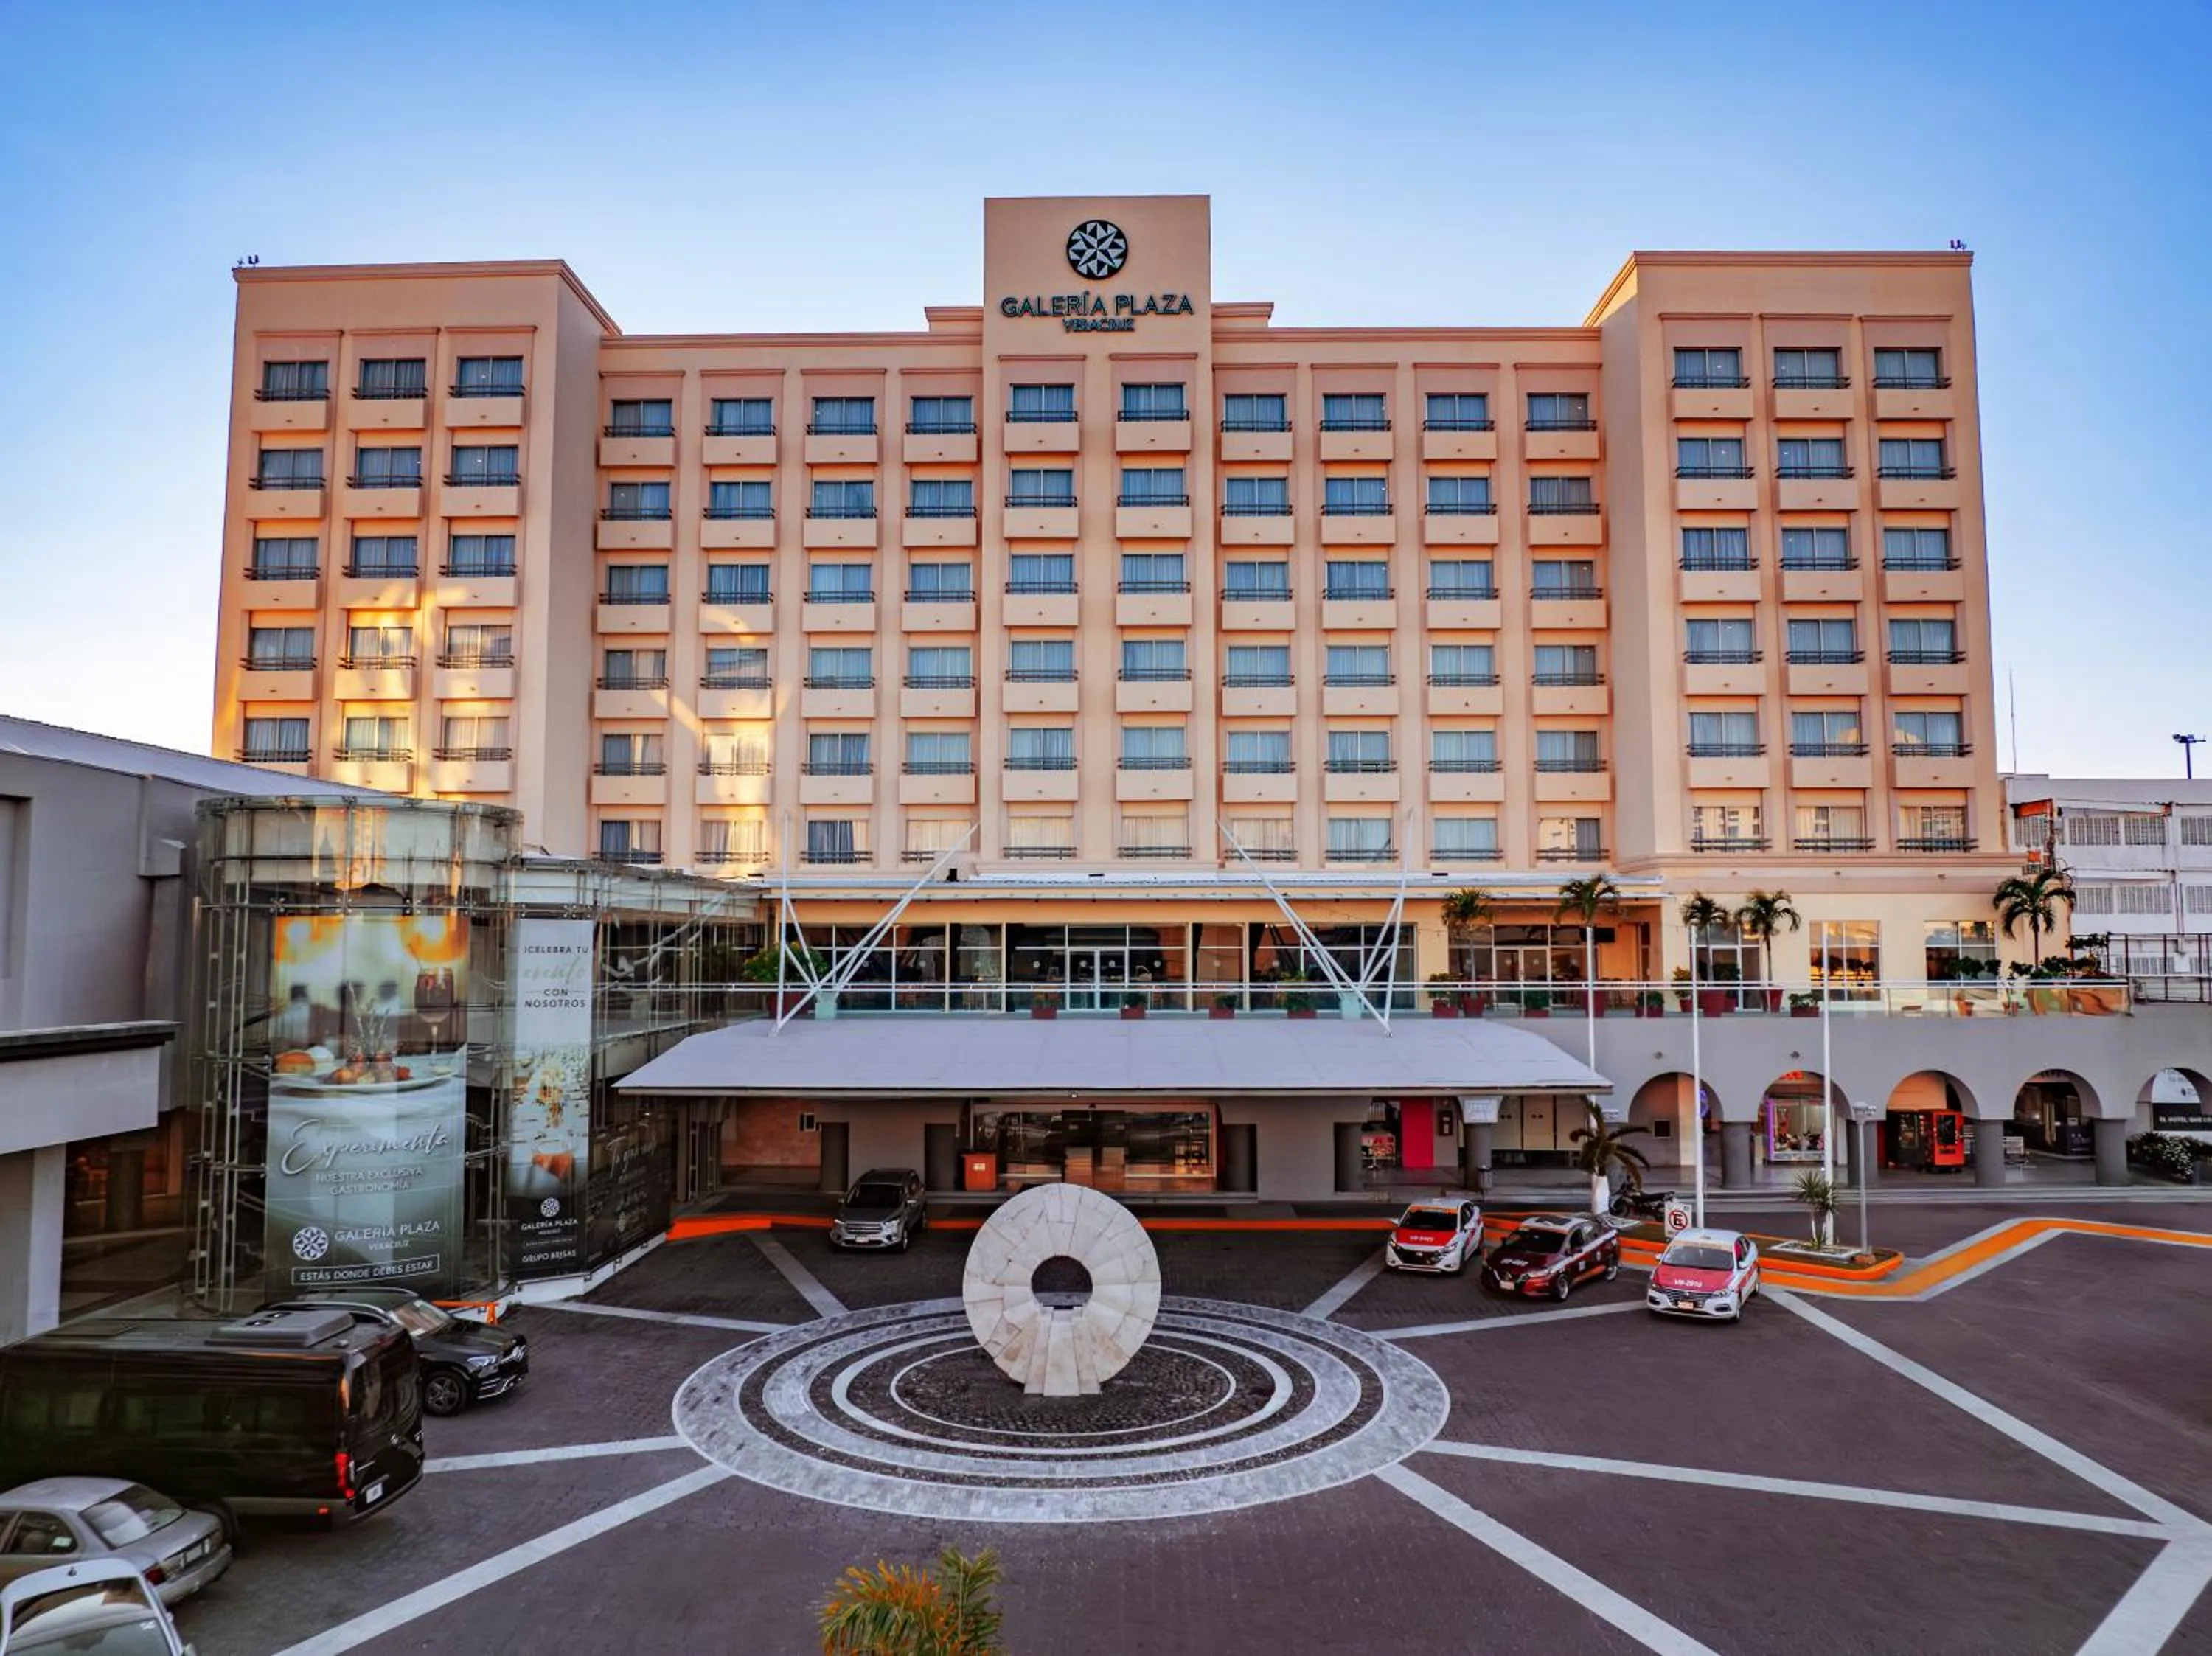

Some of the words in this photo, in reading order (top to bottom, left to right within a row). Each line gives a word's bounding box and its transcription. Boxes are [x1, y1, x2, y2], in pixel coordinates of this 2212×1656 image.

[1001, 290, 1107, 318] GALERÍA
[1116, 294, 1194, 315] PLAZA
[1062, 318, 1135, 333] VERACRUZ
[577, 946, 589, 954] TU
[524, 999, 586, 1008] NOSOTROS
[281, 1118, 449, 1175] Experimenta
[316, 1169, 364, 1183] NUESTRA
[368, 1166, 423, 1180] EXCLUSIVA
[400, 1220, 441, 1235] PLAZA
[554, 1218, 578, 1227] PLAZA
[522, 1253, 549, 1263] GRUPO
[333, 1269, 369, 1281] DONDE
[373, 1263, 403, 1276] DEBES
[406, 1260, 434, 1273] ESTAR
